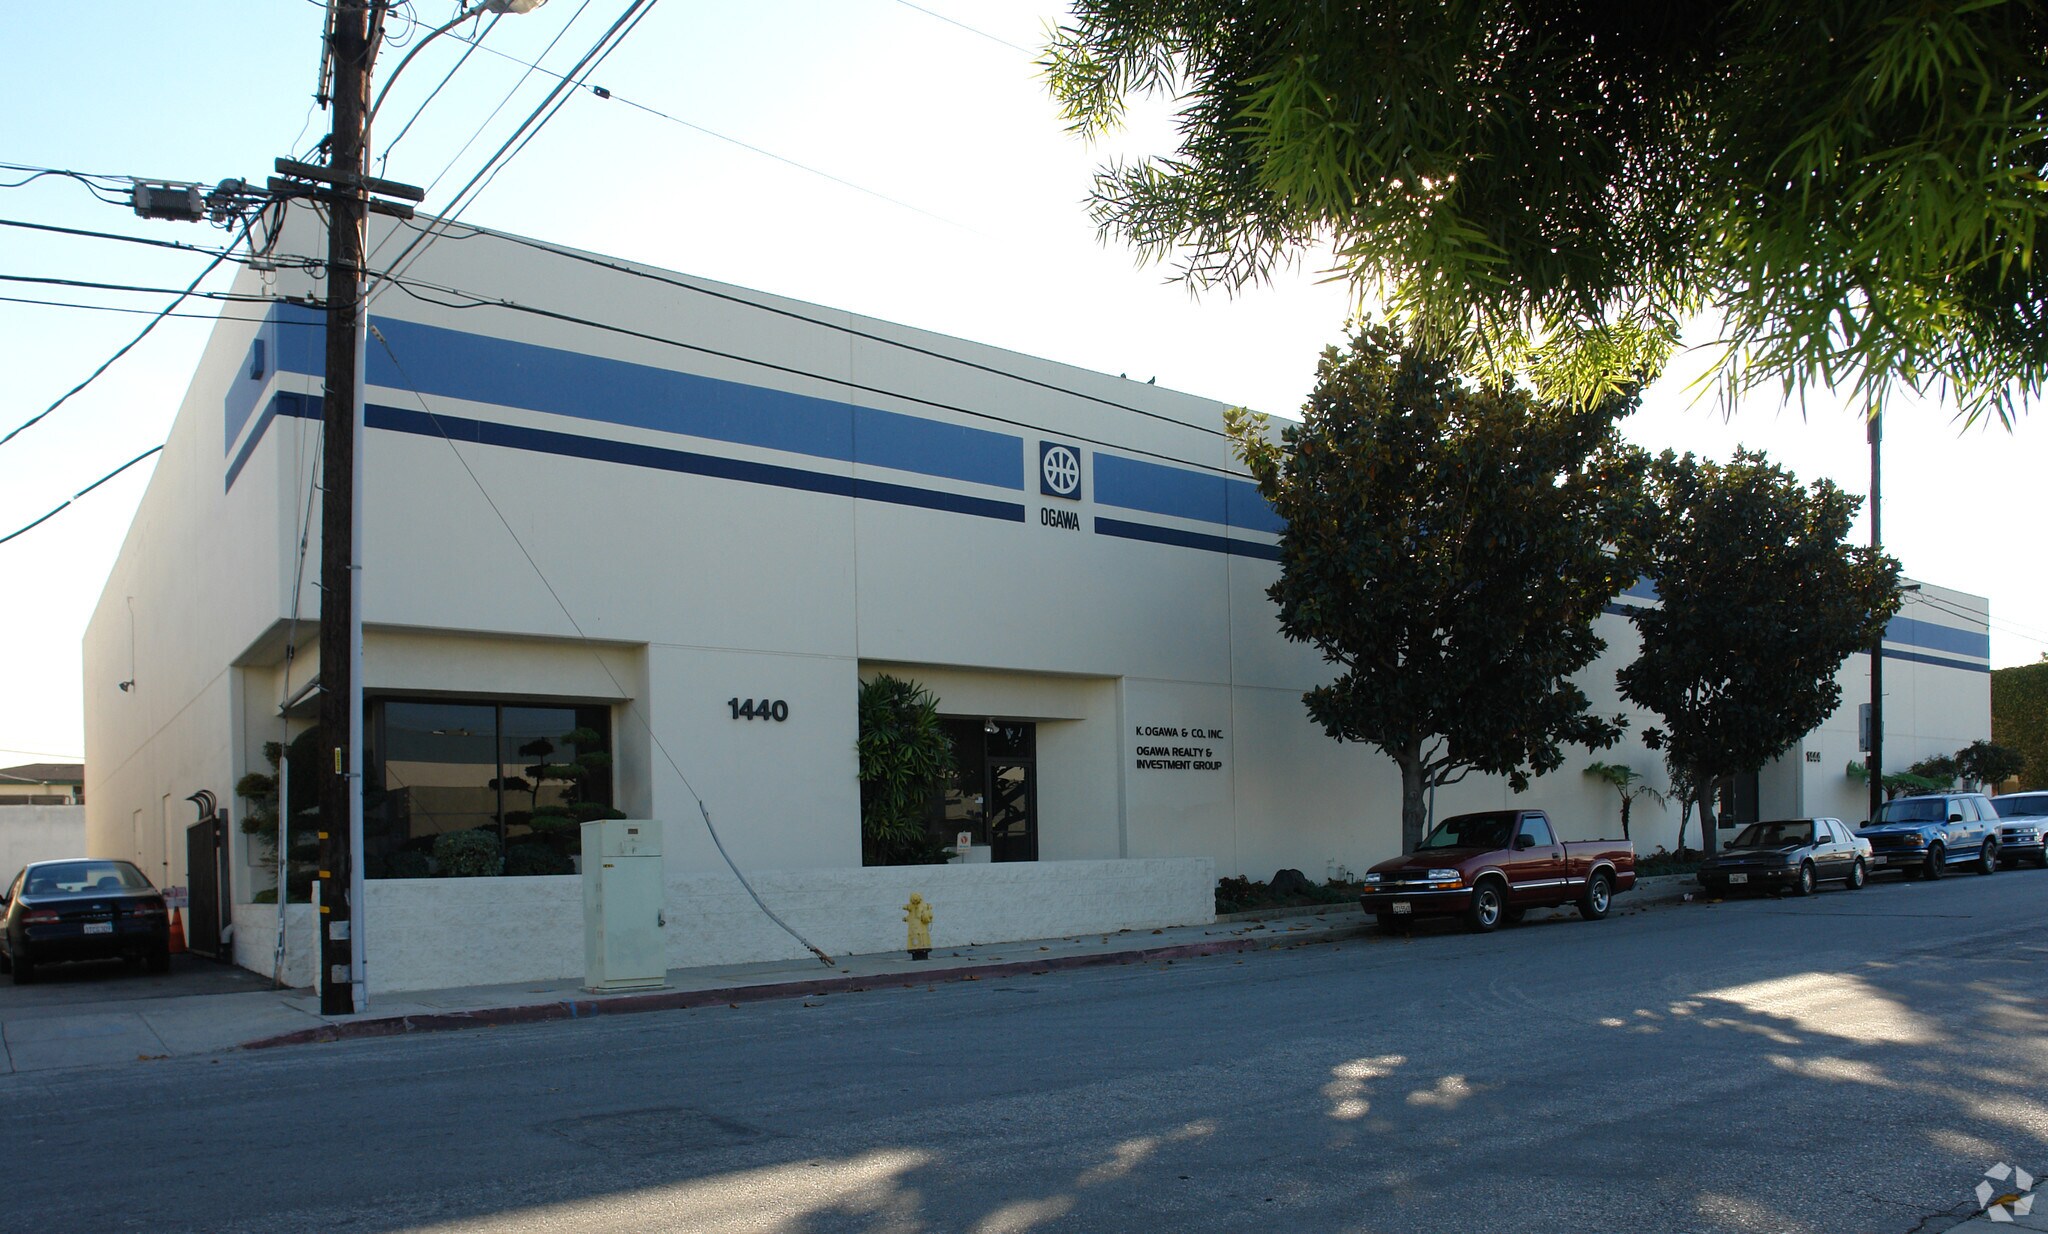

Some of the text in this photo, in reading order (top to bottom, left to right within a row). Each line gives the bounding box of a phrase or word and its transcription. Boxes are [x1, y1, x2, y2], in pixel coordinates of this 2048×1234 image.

[1041, 507, 1080, 531] OGAWA
[728, 698, 789, 722] 1440
[1145, 726, 1179, 737] OGAWA
[1181, 728, 1188, 738] &
[1136, 746, 1213, 757] OGAWA REALTY &
[1136, 759, 1222, 770] INVESTMENT GROUP
